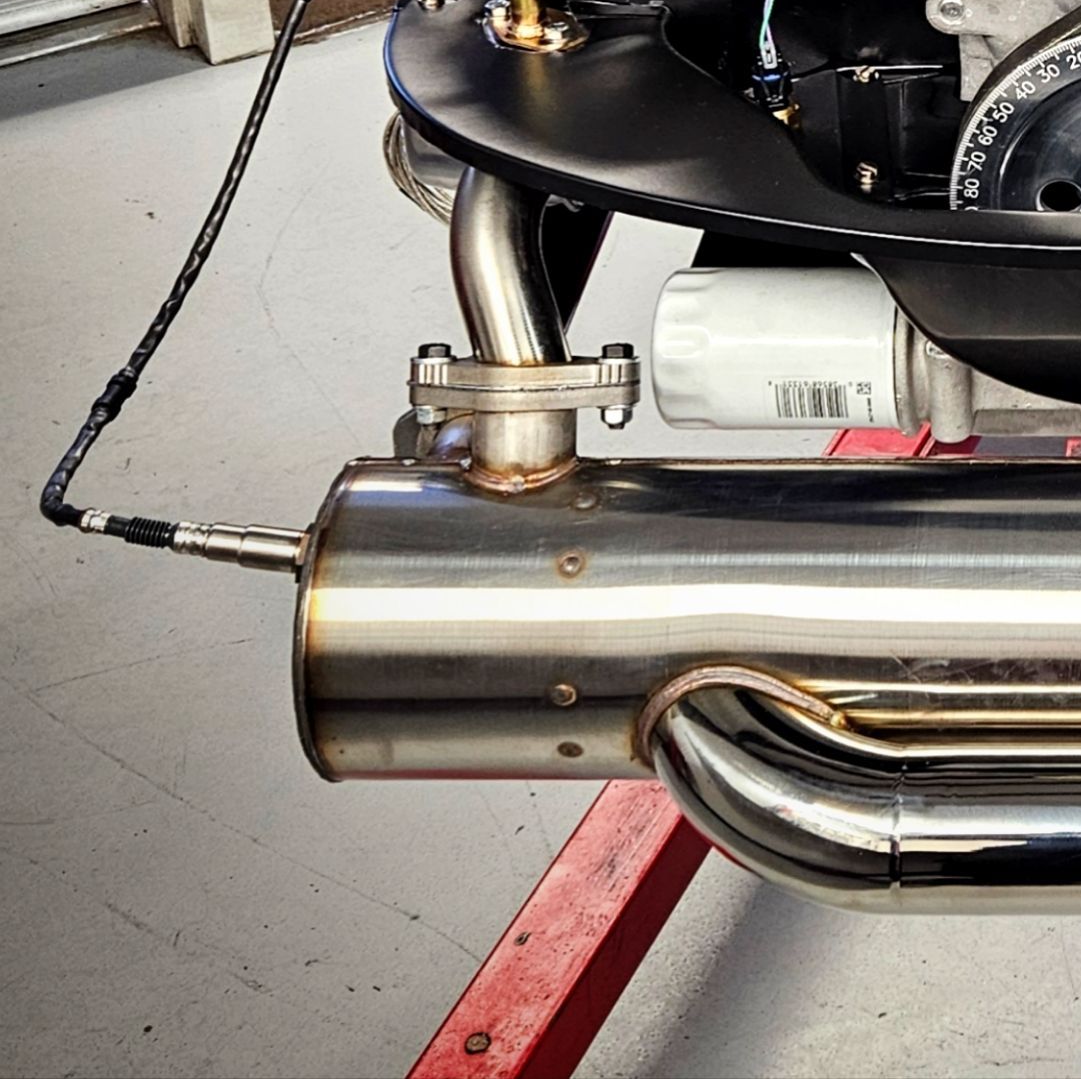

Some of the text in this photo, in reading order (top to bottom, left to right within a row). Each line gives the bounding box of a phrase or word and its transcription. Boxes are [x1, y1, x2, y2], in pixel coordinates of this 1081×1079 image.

[1036, 64, 1060, 84] 30
[1014, 81, 1036, 101] 40
[992, 101, 1015, 123] 50
[977, 125, 998, 146] 60
[967, 151, 987, 172] 70
[963, 178, 980, 199] 80
